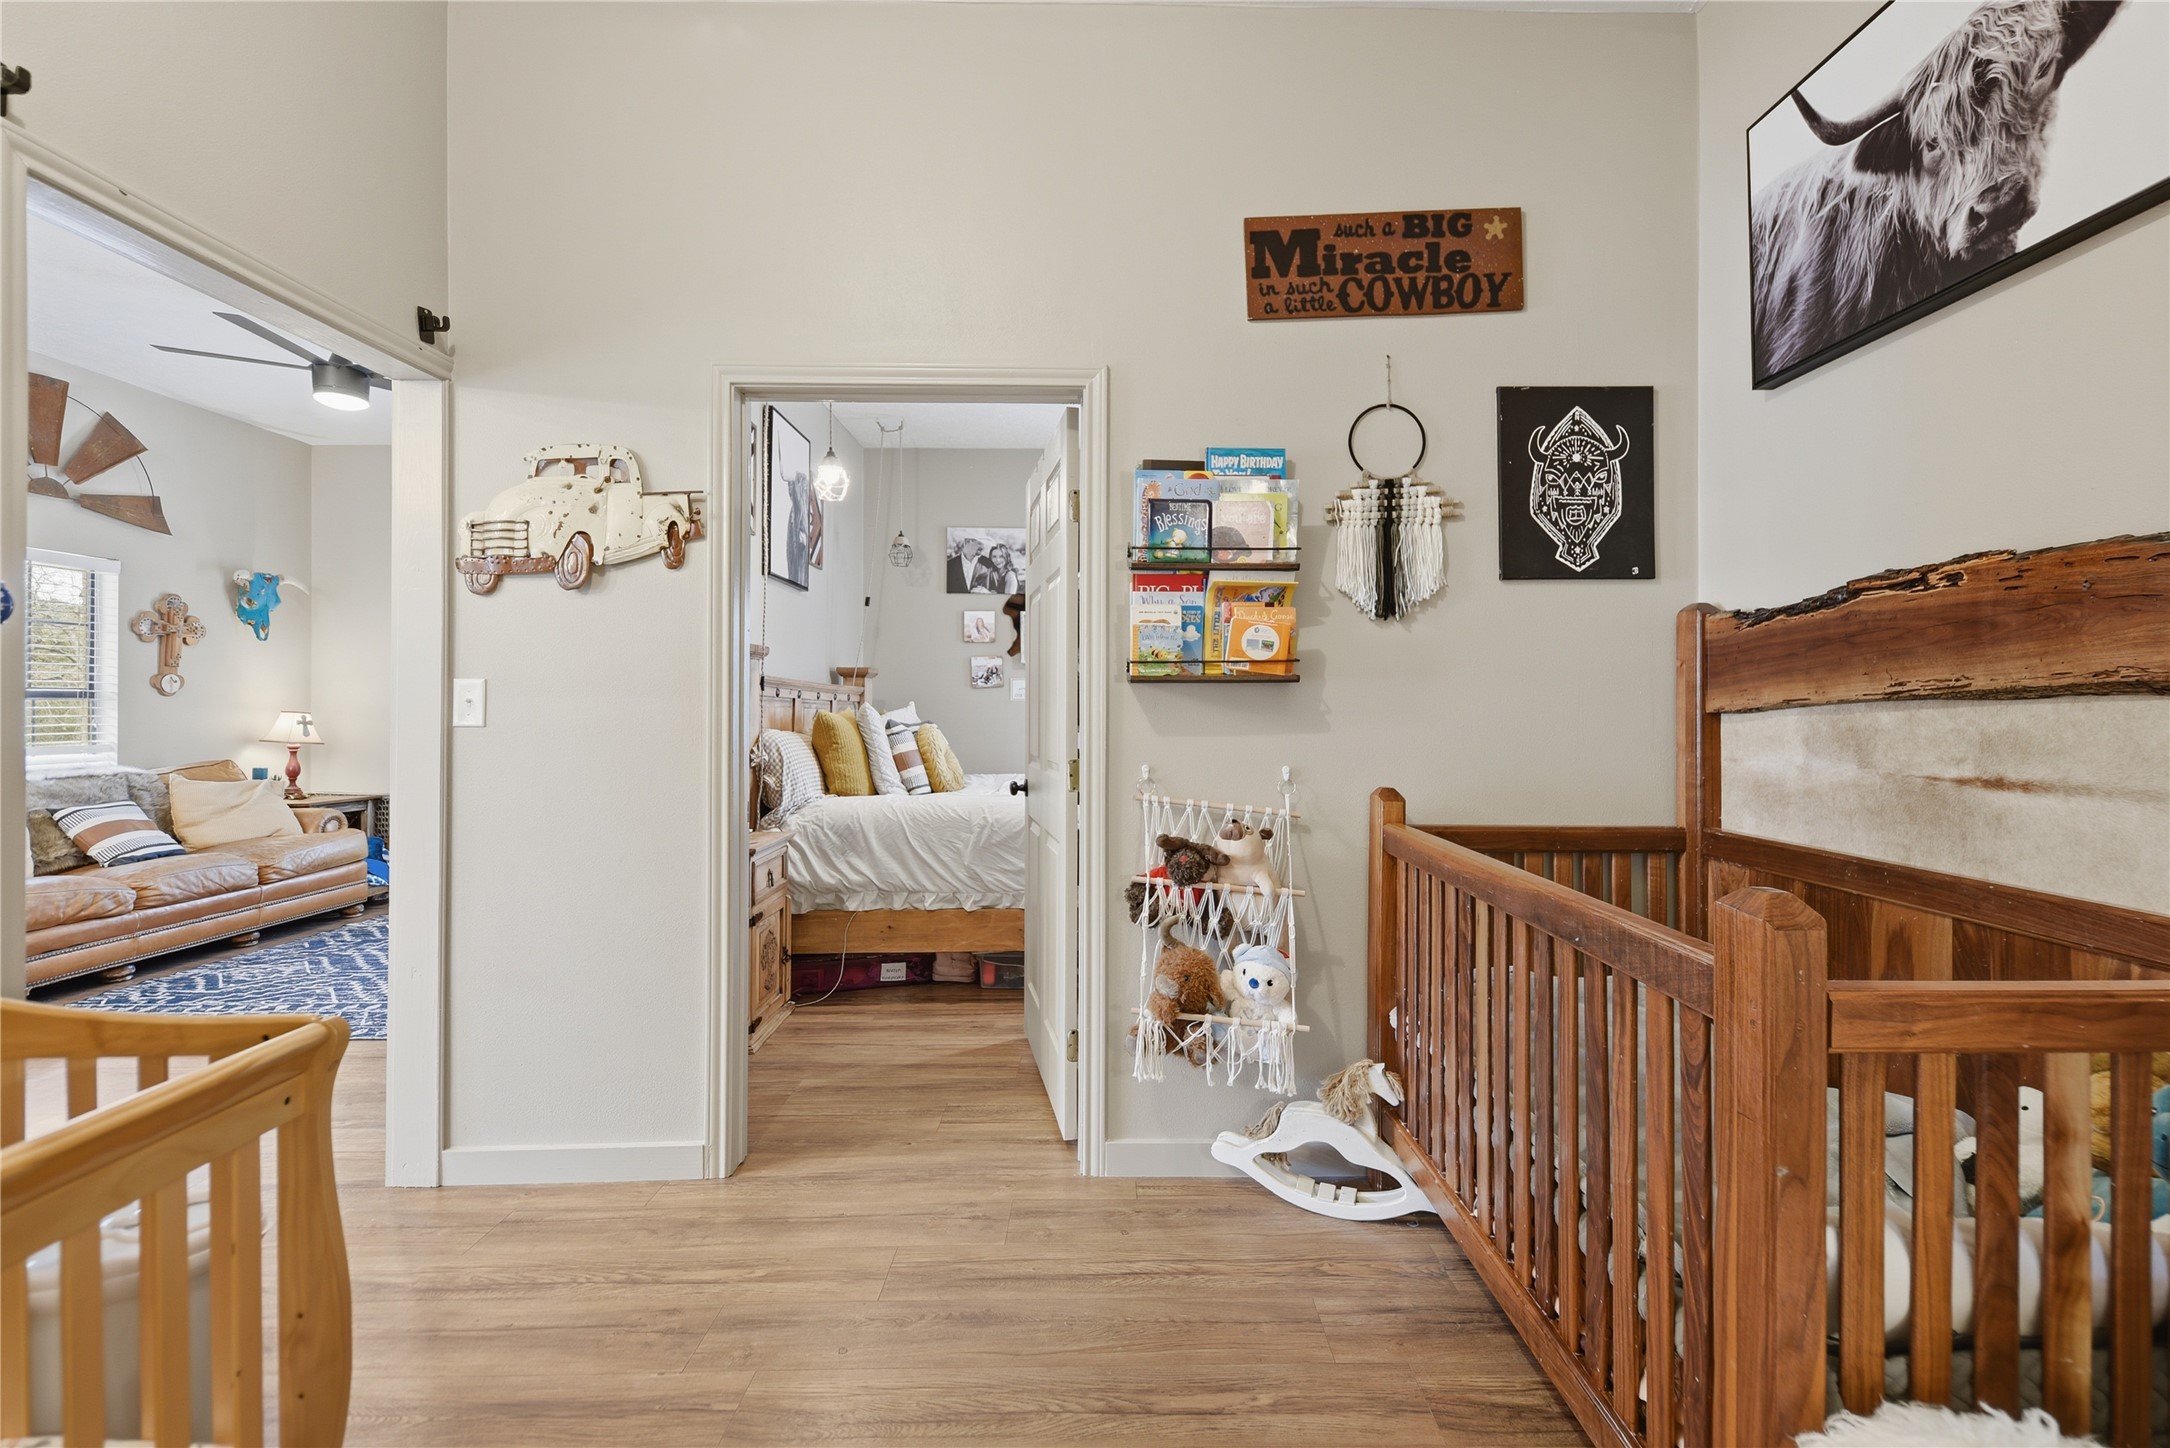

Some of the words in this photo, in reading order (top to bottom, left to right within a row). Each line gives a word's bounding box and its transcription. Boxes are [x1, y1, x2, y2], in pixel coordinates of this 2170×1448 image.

[1333, 218, 1376, 238] such
[1382, 223, 1396, 237] a
[1402, 212, 1473, 239] BIG
[1250, 228, 1472, 279] Miracle
[1259, 282, 1279, 297] in
[1286, 277, 1335, 295] such
[1336, 272, 1512, 313] COWBOY
[1264, 301, 1279, 314] a
[1284, 296, 1337, 314] little
[1211, 455, 1239, 468] HAPPY
[1240, 454, 1284, 468] BIRTHDAY
[1174, 483, 1202, 496] God
[1154, 511, 1207, 535] Blessings
